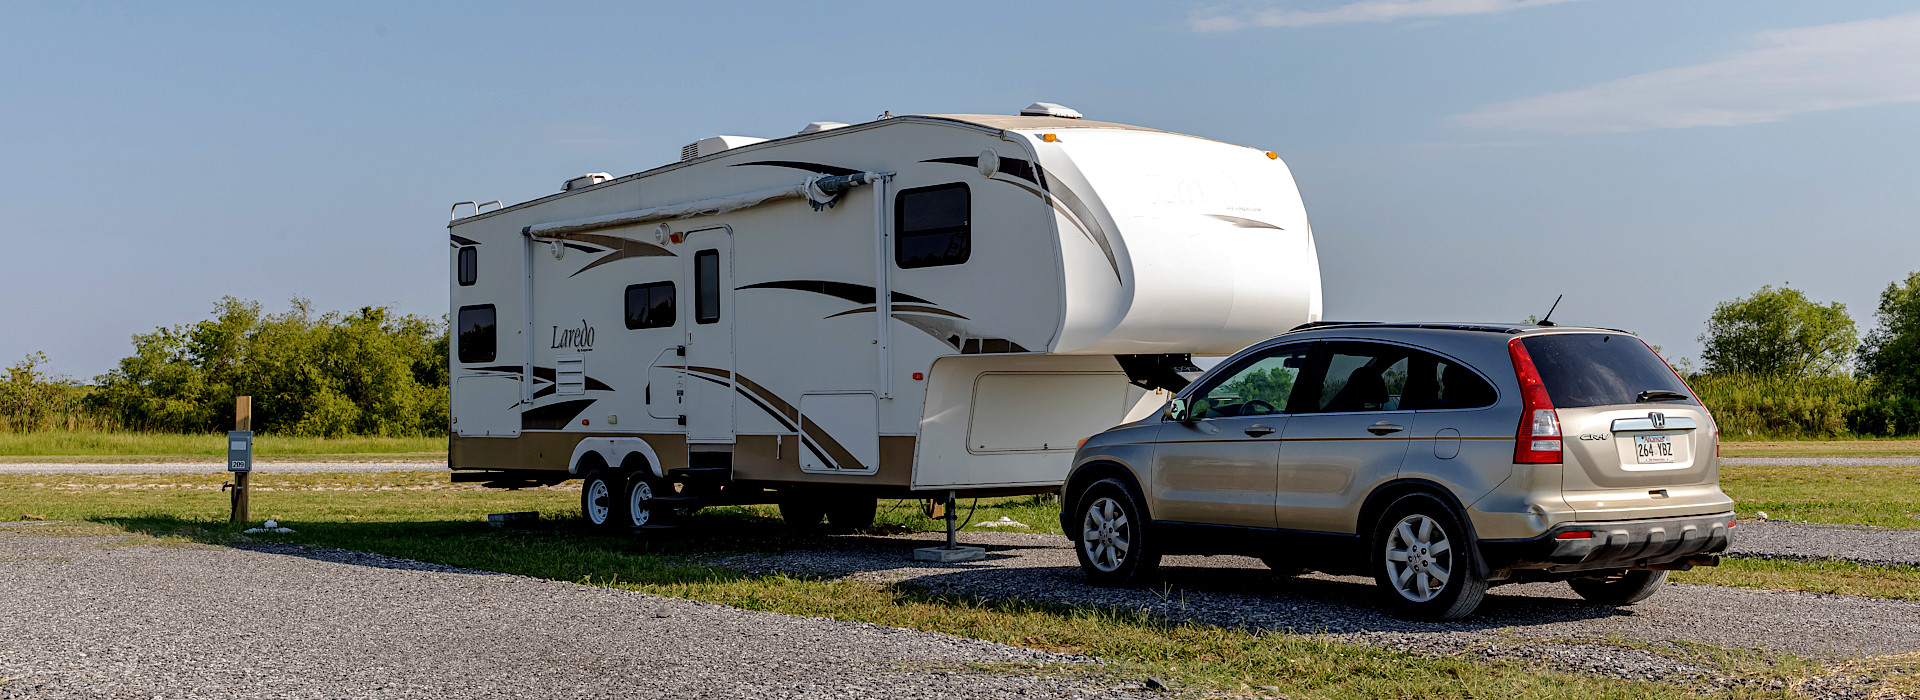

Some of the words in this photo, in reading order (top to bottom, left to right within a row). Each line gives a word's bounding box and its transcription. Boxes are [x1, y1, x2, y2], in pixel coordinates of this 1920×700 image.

[551, 319, 595, 348] Laredo
[1638, 444, 1653, 457] 264
[1657, 443, 1673, 456] YBZ
